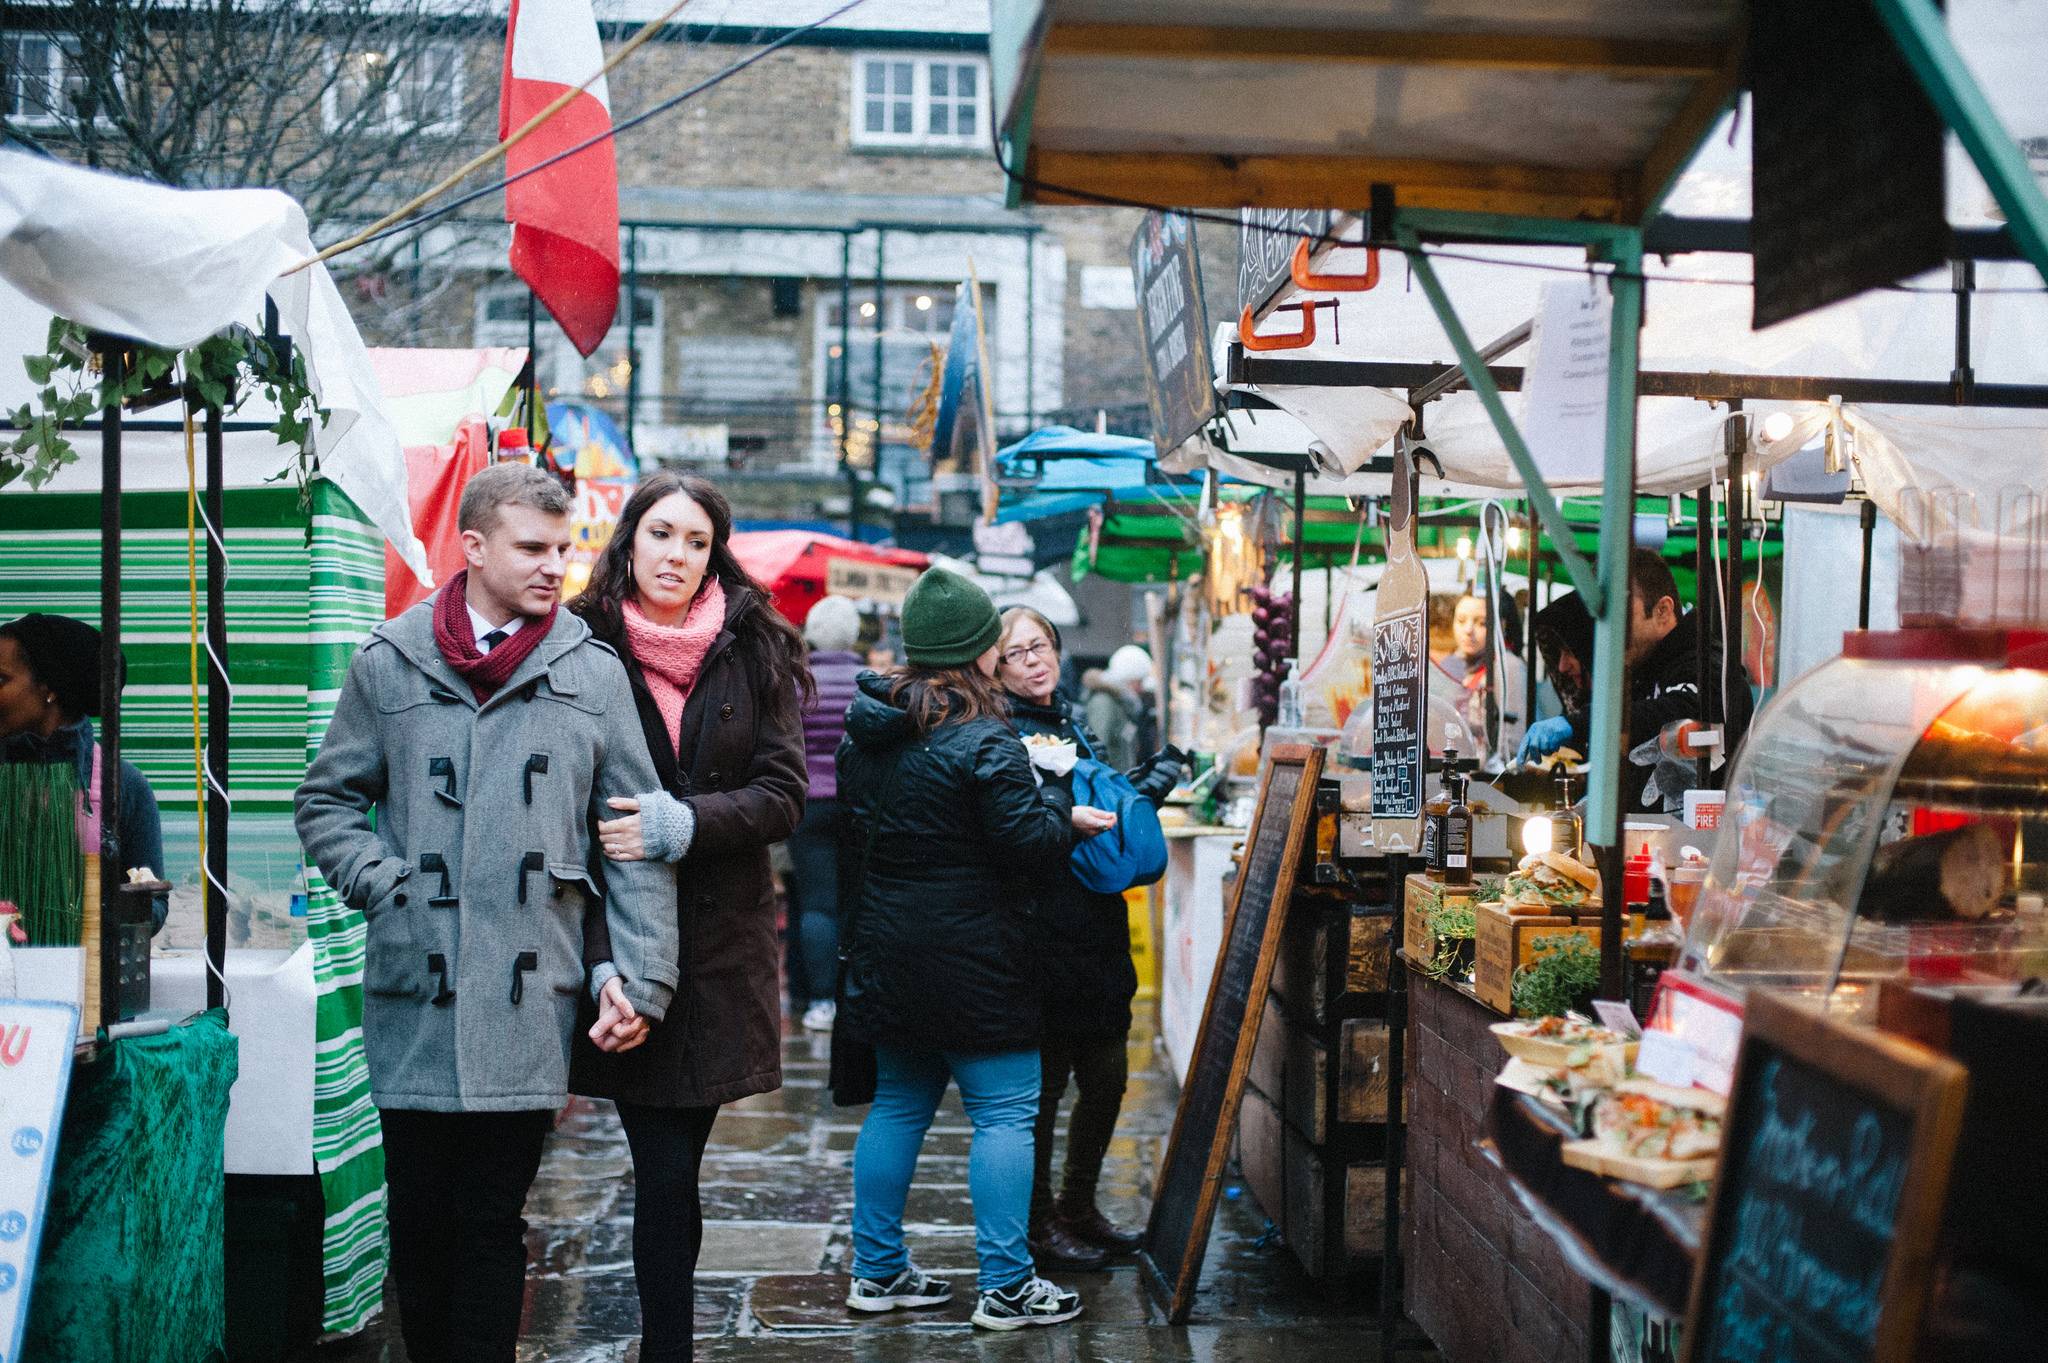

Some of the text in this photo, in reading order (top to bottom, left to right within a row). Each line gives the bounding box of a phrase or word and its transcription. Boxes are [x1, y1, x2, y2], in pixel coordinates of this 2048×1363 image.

[1408, 660, 1418, 679] Pork
[1393, 697, 1411, 711] Mustard
[1391, 713, 1402, 727] Salad
[1695, 814, 1714, 828] FIRE
